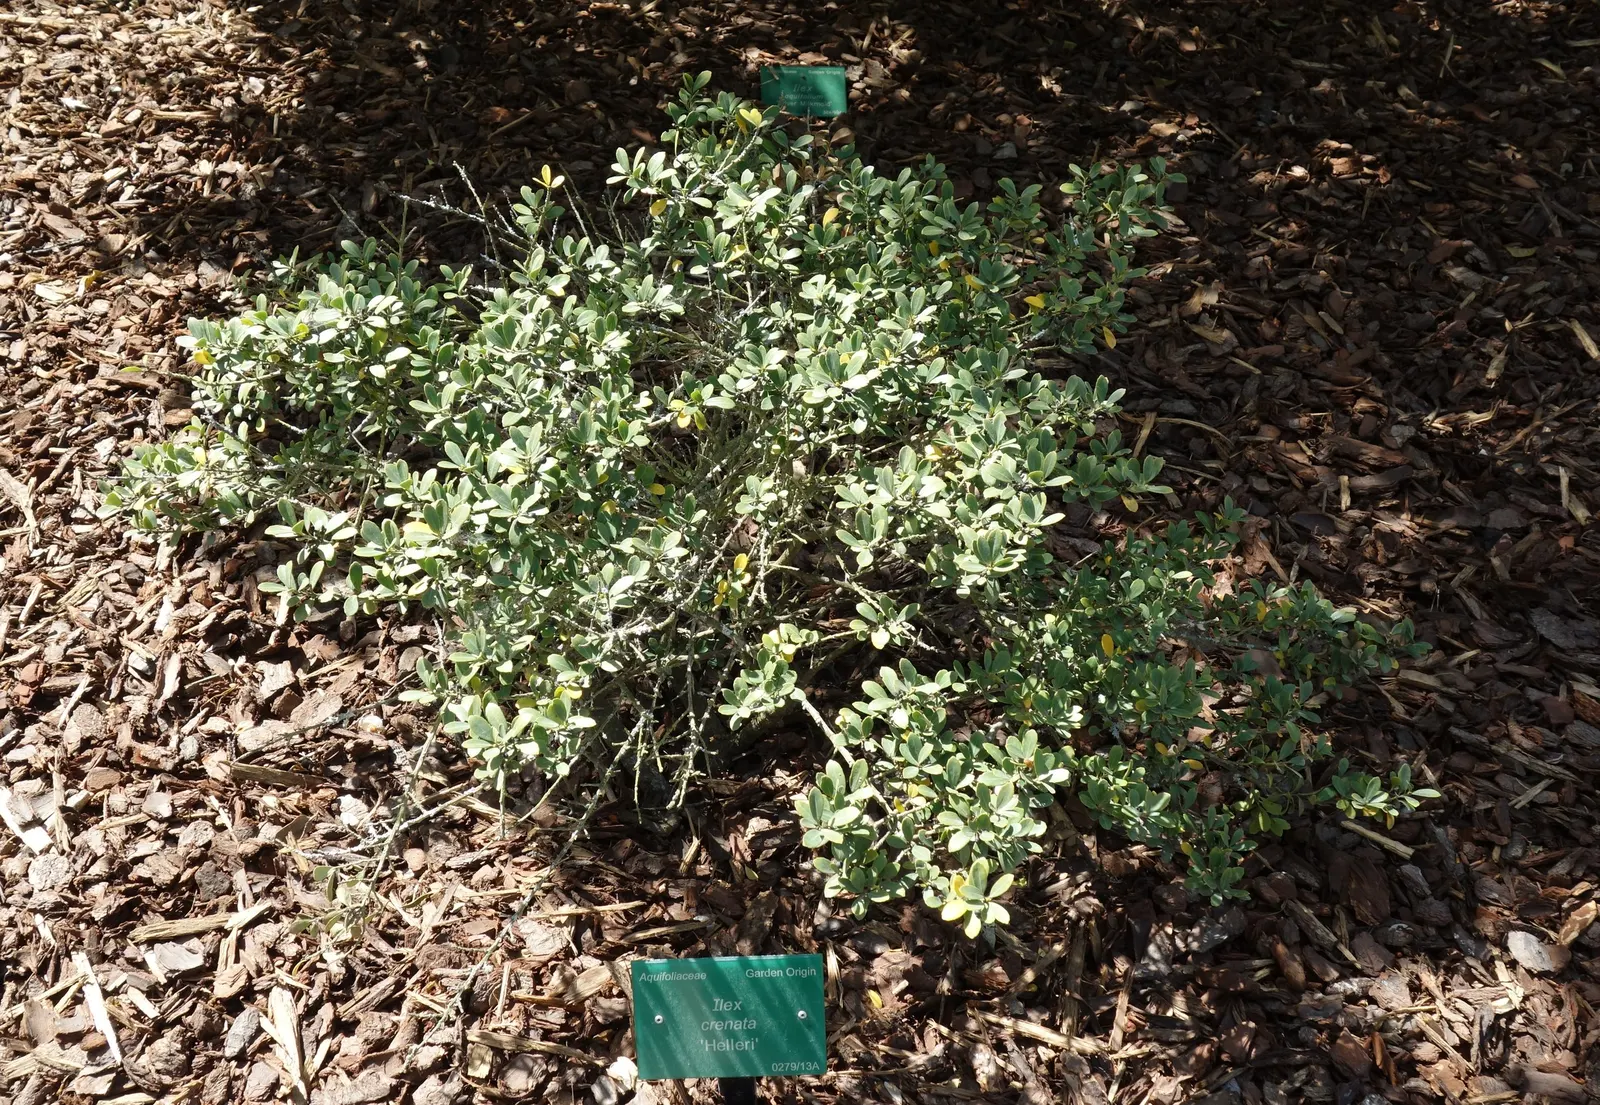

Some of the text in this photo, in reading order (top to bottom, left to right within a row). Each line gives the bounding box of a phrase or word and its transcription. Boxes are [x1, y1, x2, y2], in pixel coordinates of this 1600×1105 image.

[793, 84, 812, 92] Ilex
[639, 967, 817, 982] Aquifoliaceae Garden Origin
[712, 999, 742, 1012] Ilex
[701, 1018, 757, 1031] crenata
[700, 1038, 759, 1052] 'Helleri'
[771, 1062, 820, 1072] 0279/13A
